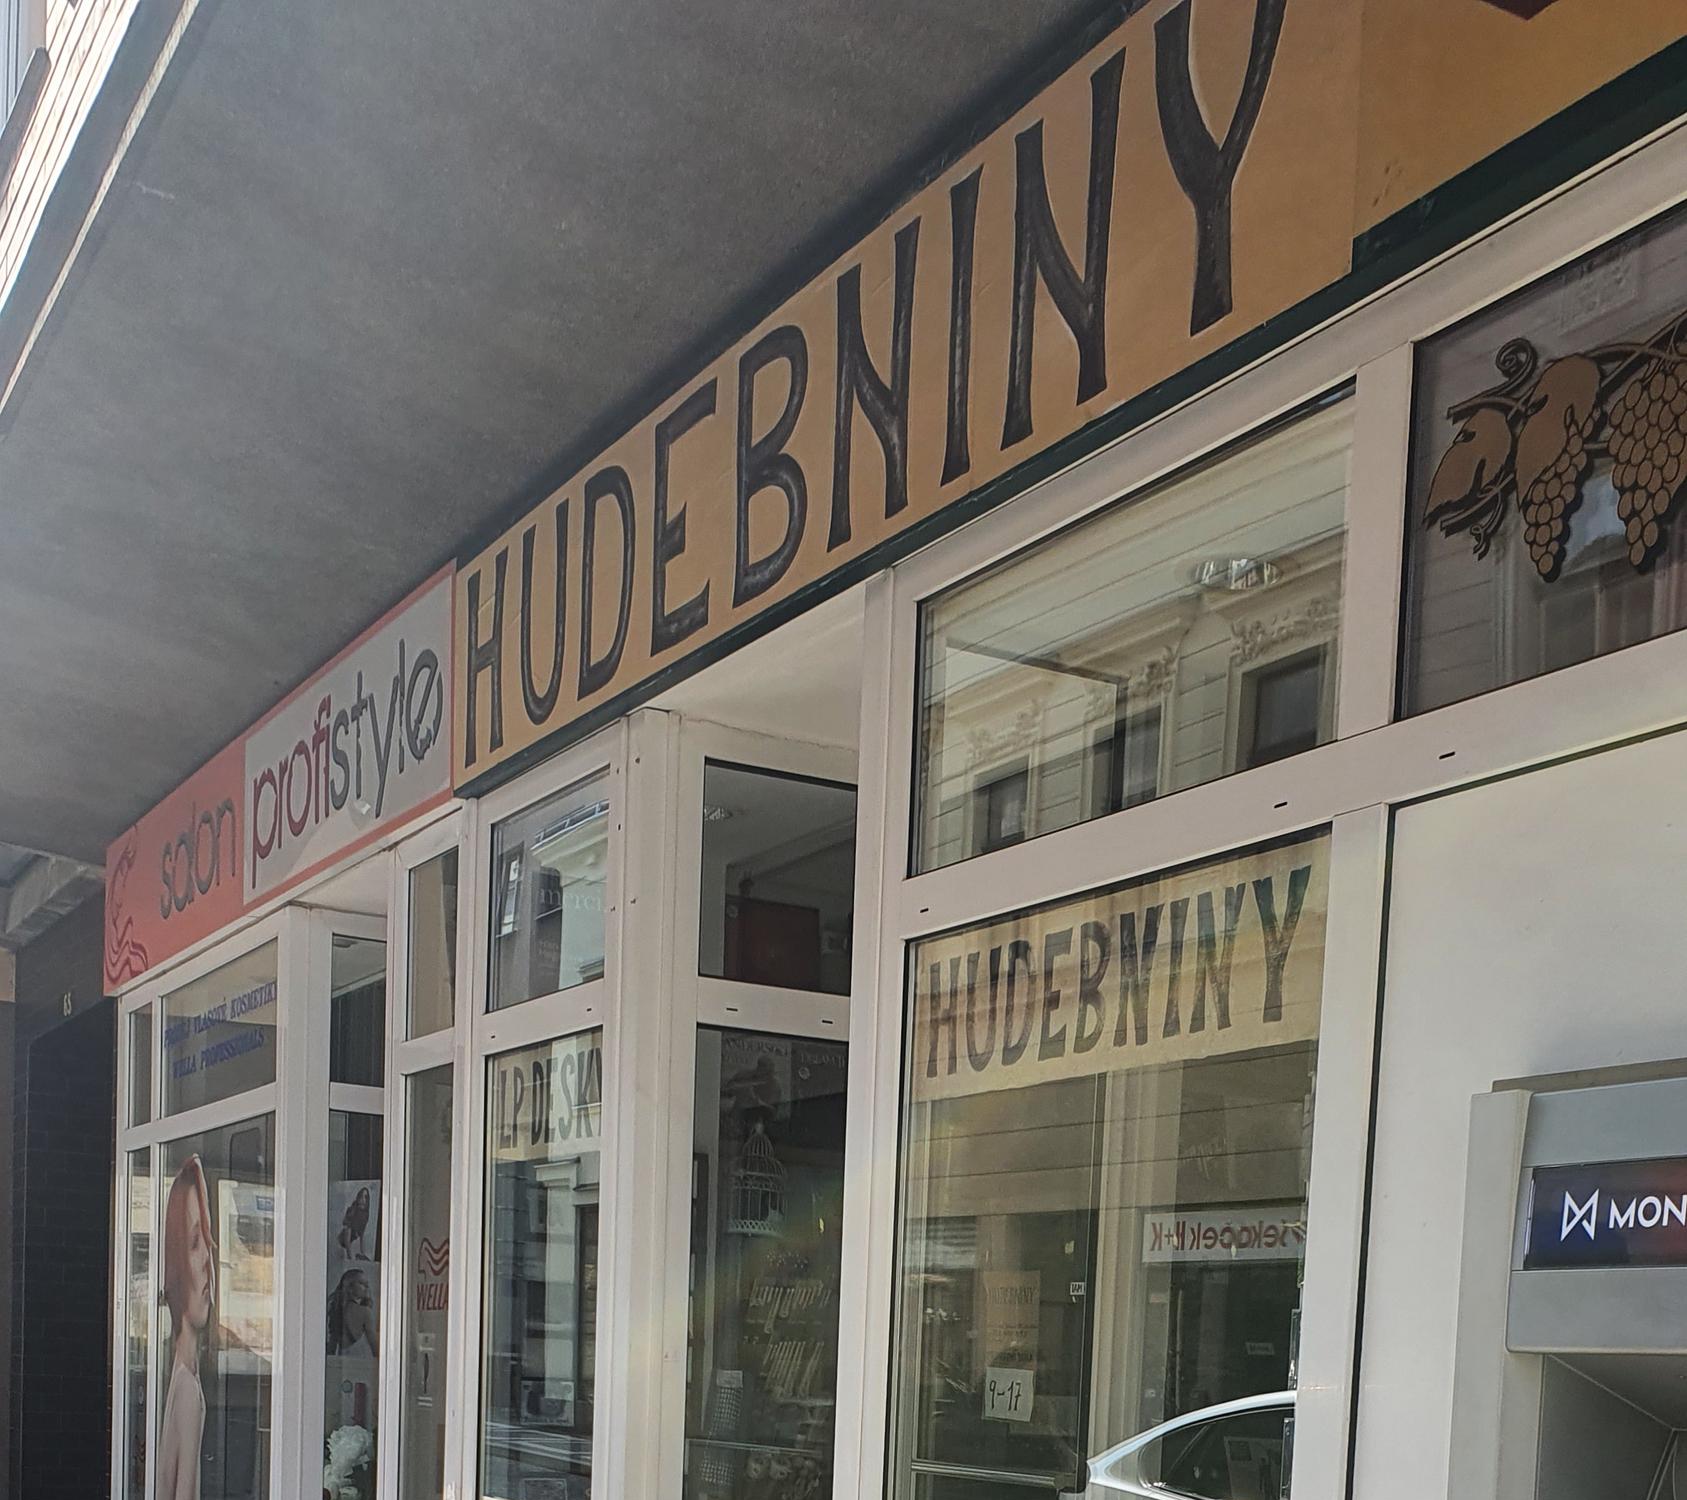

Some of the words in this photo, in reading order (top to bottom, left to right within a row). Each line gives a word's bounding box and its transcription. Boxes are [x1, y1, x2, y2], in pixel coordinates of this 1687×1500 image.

[464, 0, 1287, 767] HUDEBNINY
[160, 797, 236, 920] salon
[251, 638, 443, 889] profistyle
[926, 865, 1312, 1079] HUDEBNINY
[499, 1066, 525, 1149] LP
[1608, 1194, 1687, 1229] MON
[416, 1283, 449, 1311] WELLA
